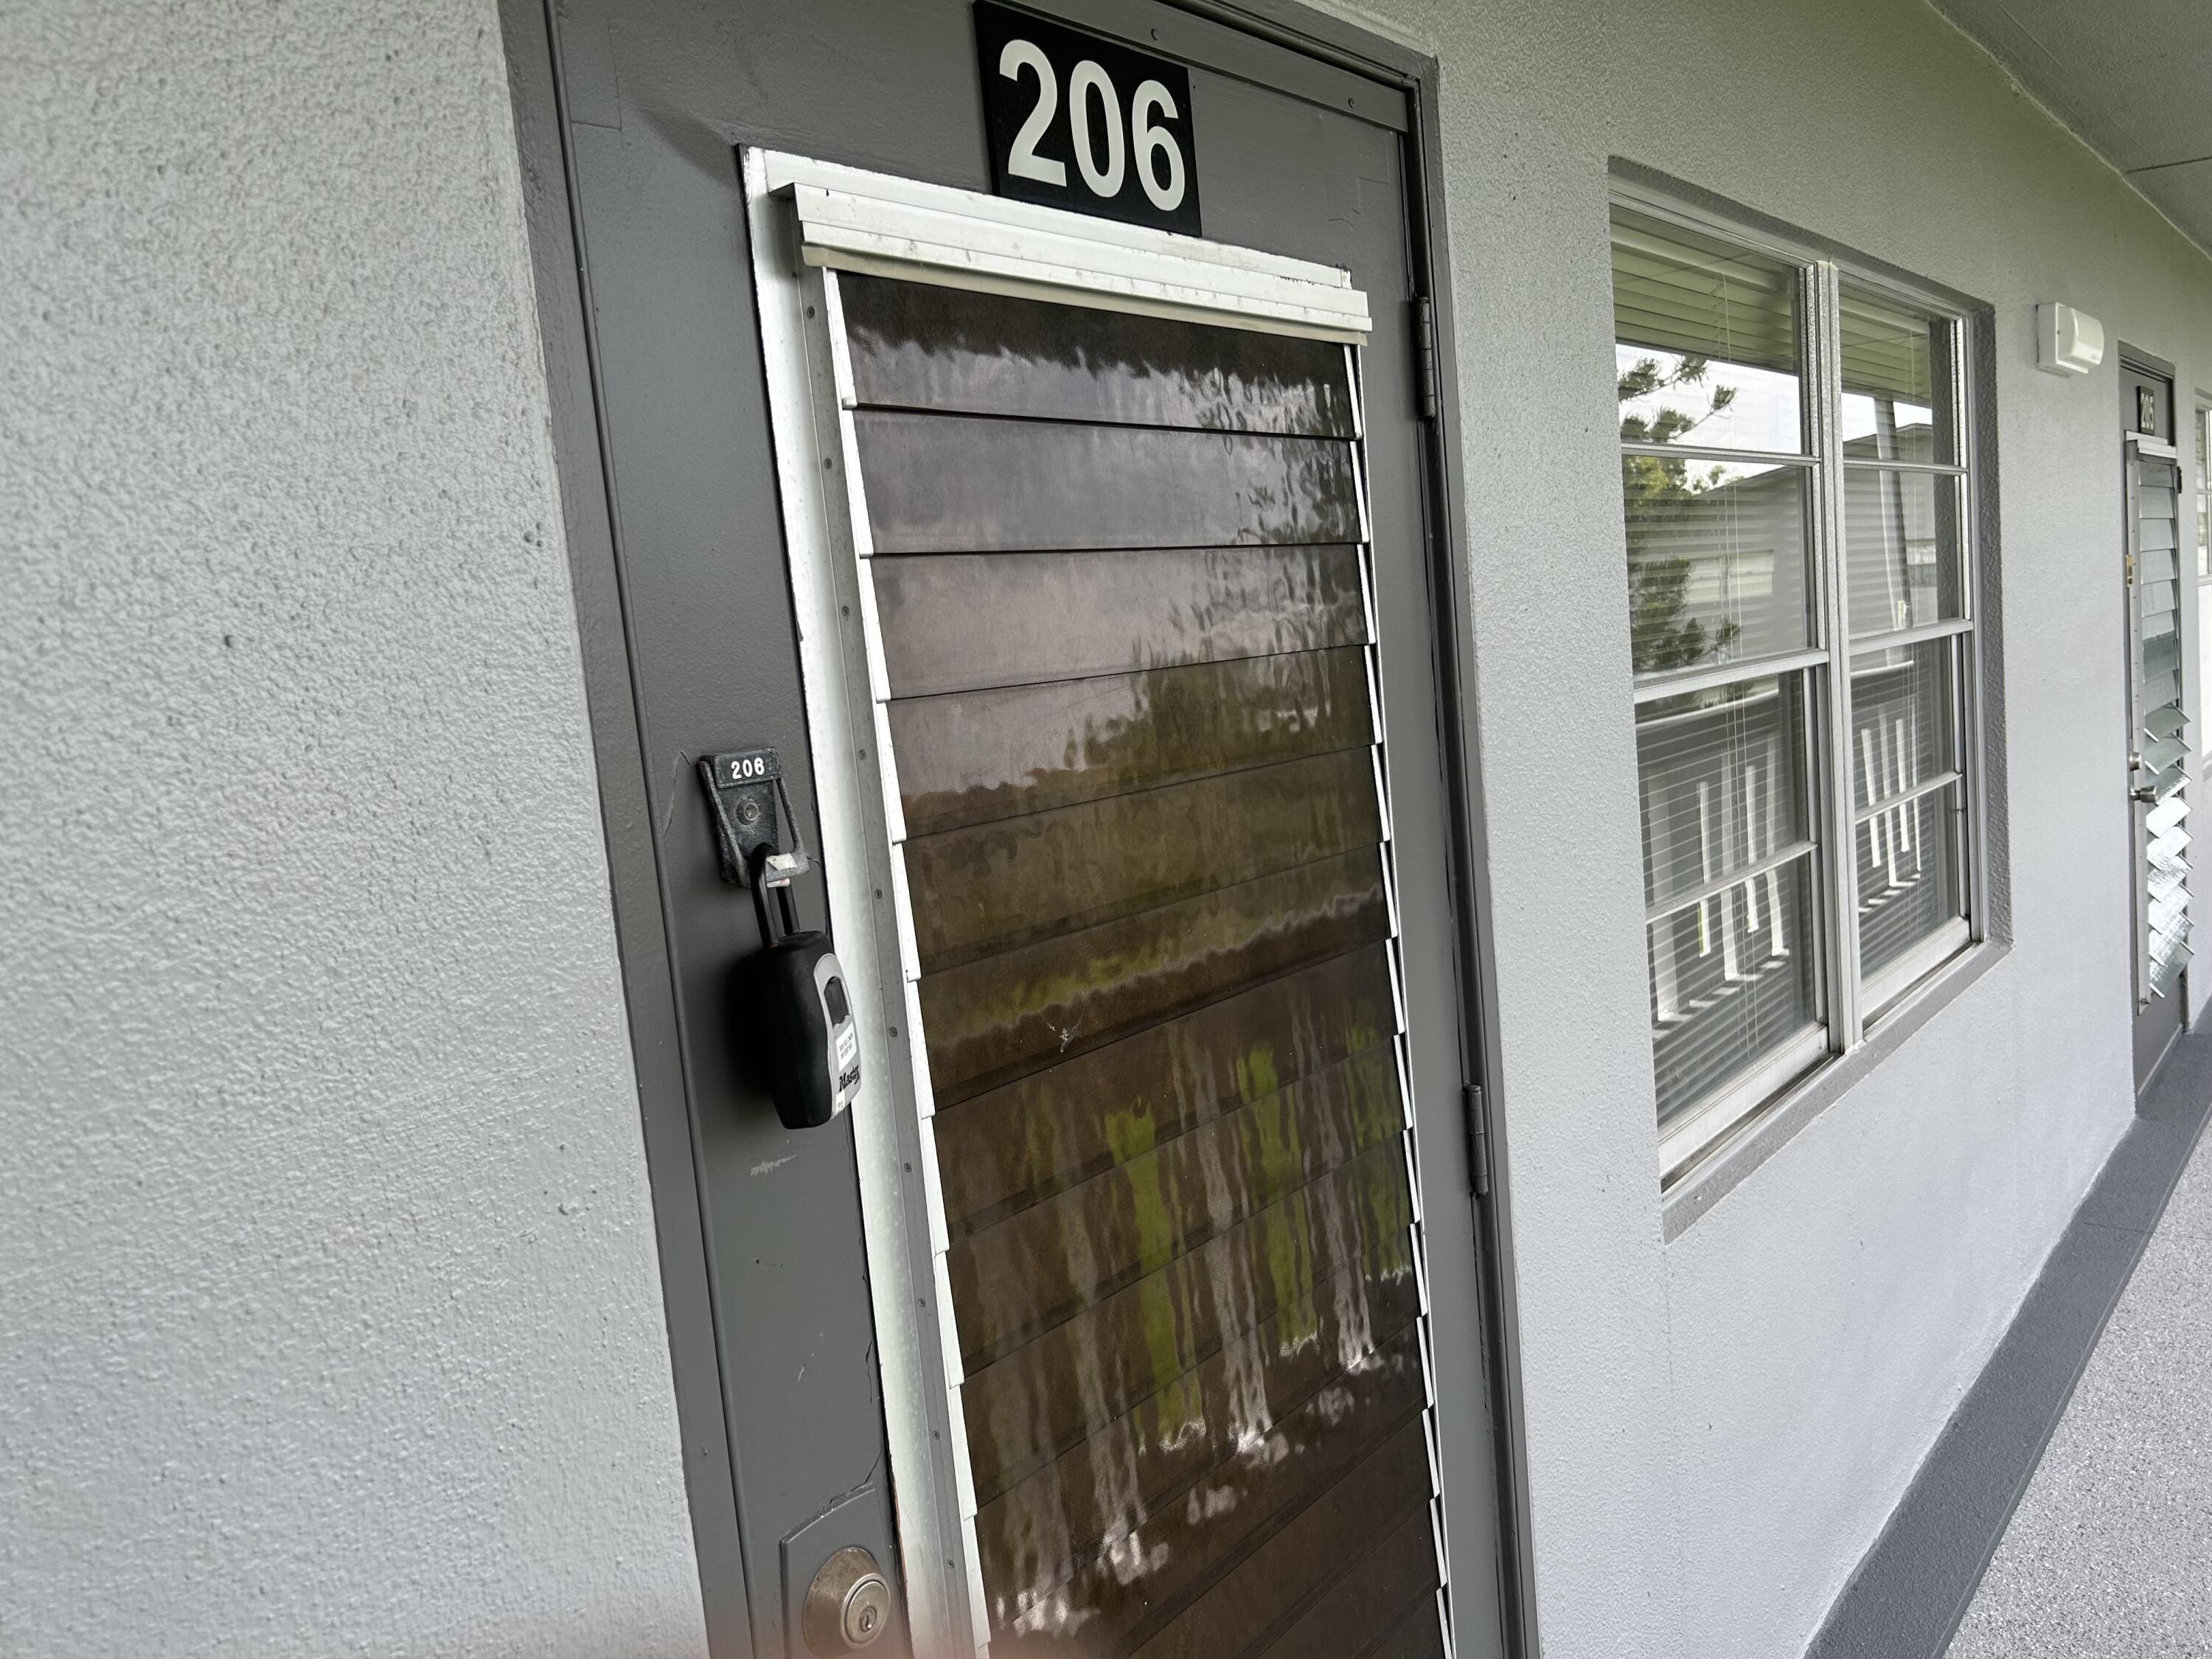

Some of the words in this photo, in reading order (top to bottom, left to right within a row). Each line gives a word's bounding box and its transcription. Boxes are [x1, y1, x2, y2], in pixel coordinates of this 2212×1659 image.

[999, 39, 1185, 212] 206
[2140, 392, 2154, 431] 205
[731, 757, 765, 779] 206
